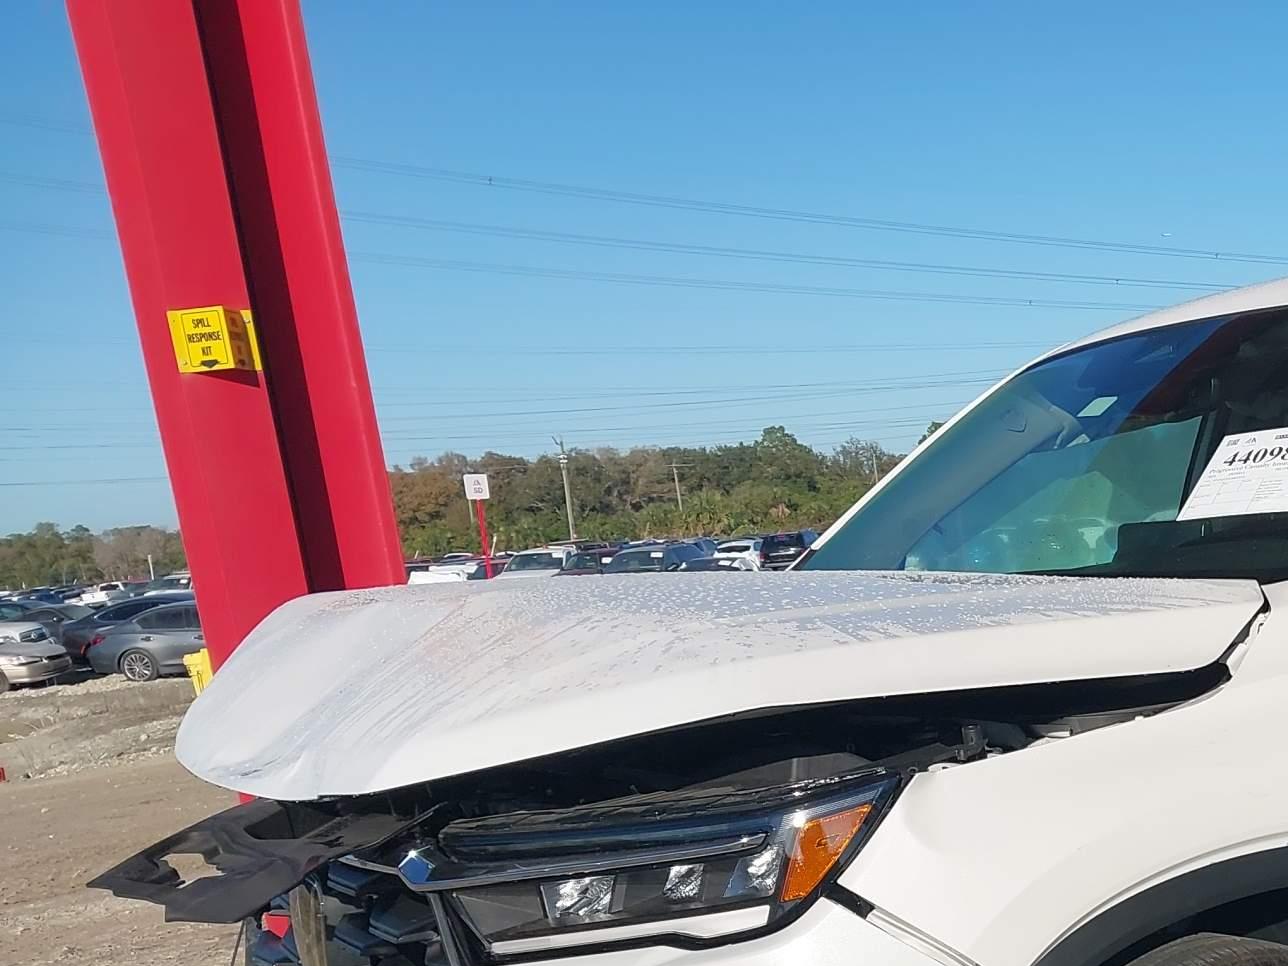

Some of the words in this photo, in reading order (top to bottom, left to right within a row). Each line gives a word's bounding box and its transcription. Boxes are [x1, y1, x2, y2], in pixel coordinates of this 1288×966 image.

[191, 317, 211, 328] SPILL
[186, 331, 223, 344] RESPONSE
[201, 346, 212, 356] KIT
